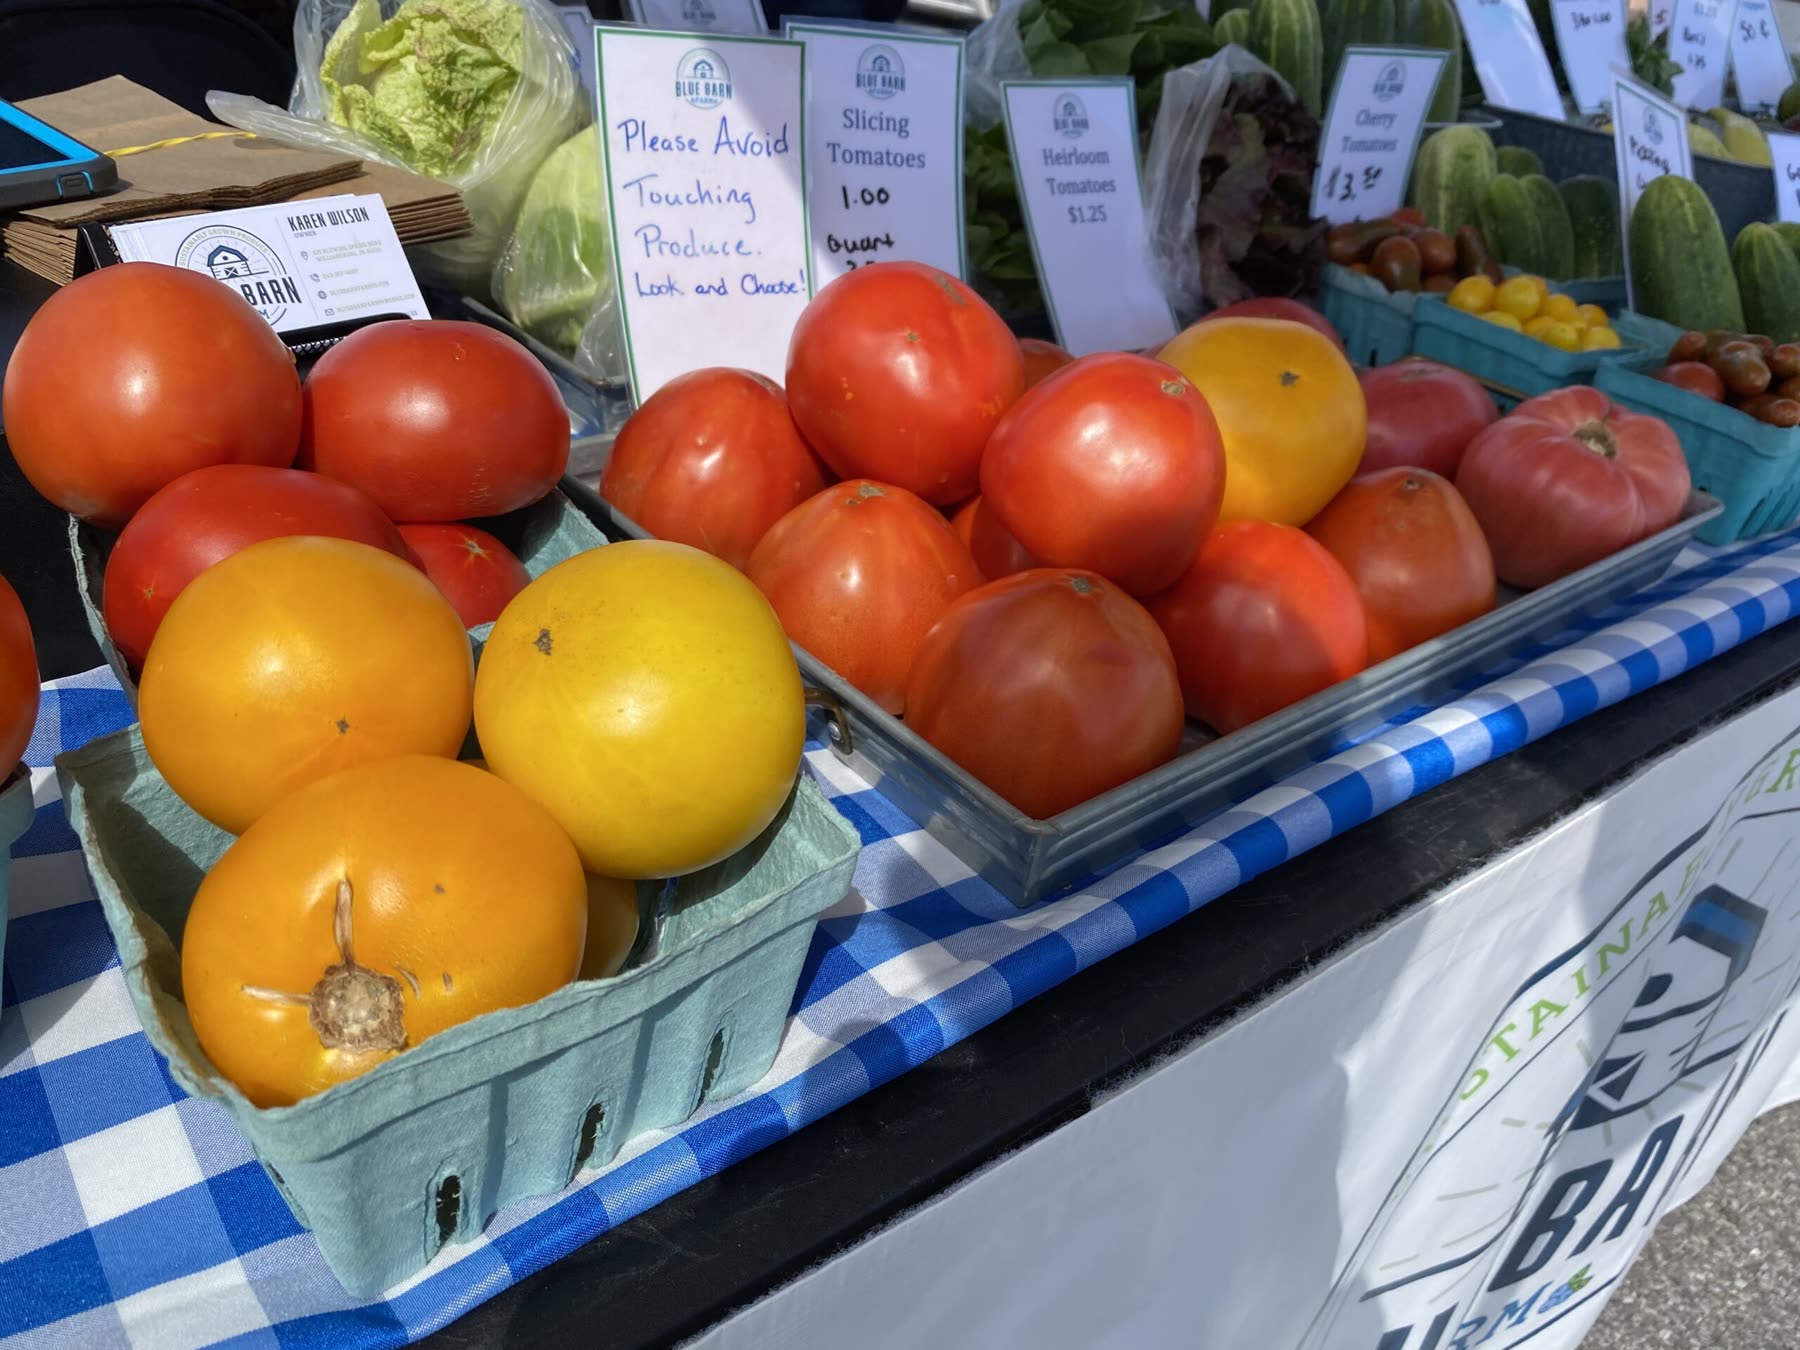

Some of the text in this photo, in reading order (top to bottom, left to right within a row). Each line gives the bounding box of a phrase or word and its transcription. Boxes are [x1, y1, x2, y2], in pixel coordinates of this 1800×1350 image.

[675, 80, 733, 100] BLUE BARN
[843, 108, 910, 139] Slicing
[1355, 107, 1398, 130] Cherry
[617, 115, 790, 157] Please Avoid
[1341, 136, 1399, 152] Tomatoes
[827, 142, 927, 169] Tomatoes
[1042, 147, 1110, 167] Heirloom
[622, 173, 757, 225] Touching
[841, 185, 890, 210] 1.00
[1045, 177, 1117, 196] Tomatoes
[287, 207, 371, 232] KAREN WILSON
[1067, 204, 1108, 224] $1.25
[207, 228, 237, 237] GROWN
[237, 231, 268, 254] PRODUCE
[827, 231, 895, 254] Quart
[240, 276, 303, 307] BARN
[635, 271, 685, 298] Look
[695, 277, 729, 296] and
